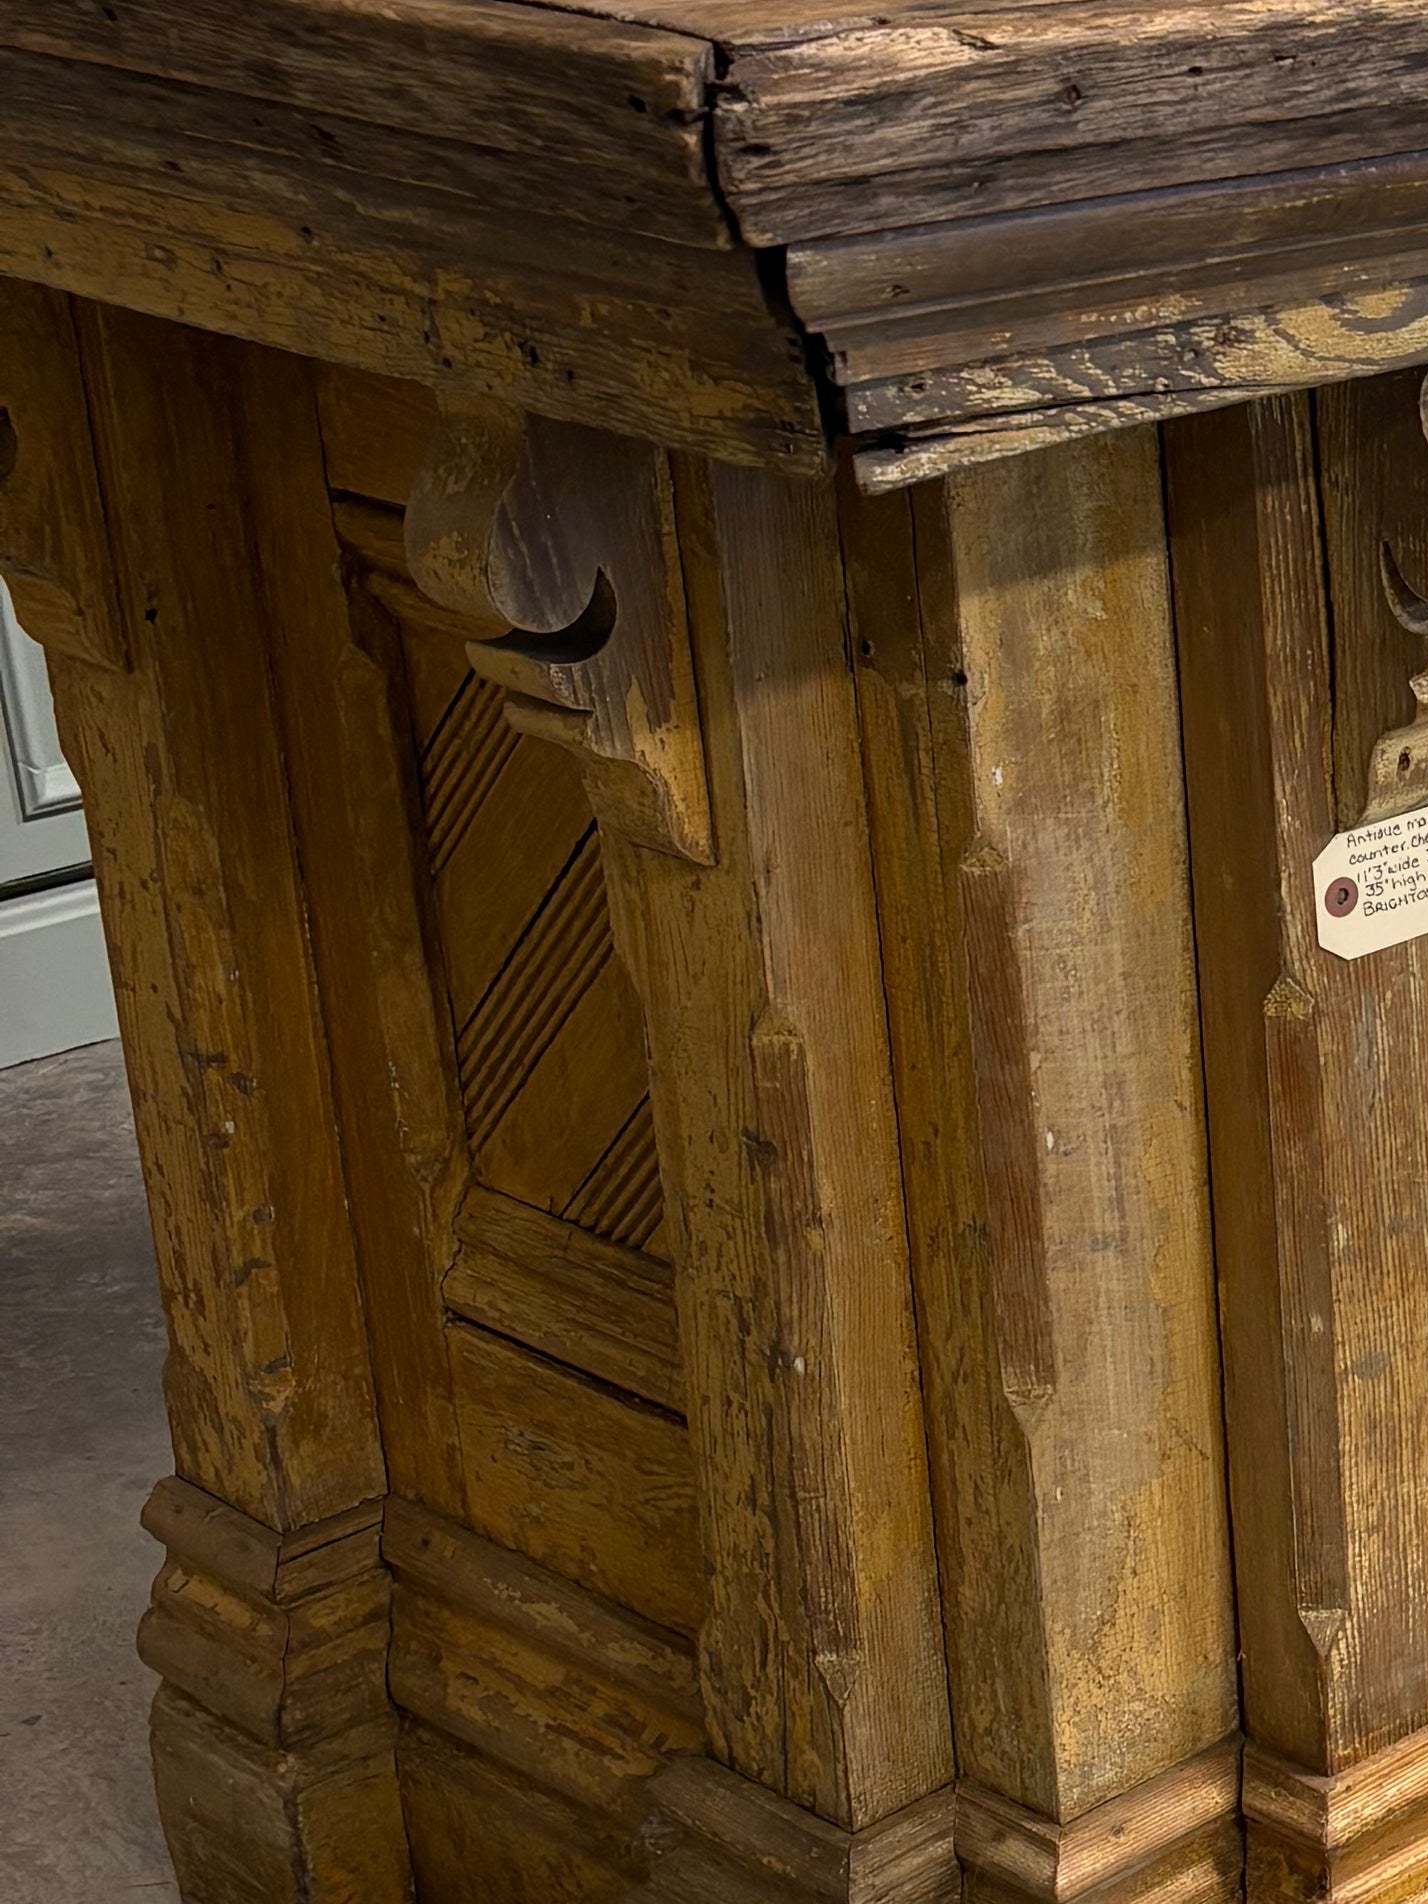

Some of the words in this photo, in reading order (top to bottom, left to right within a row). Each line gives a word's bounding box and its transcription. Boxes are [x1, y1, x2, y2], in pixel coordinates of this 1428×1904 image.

[1346, 824, 1402, 849] Antique
[1387, 856, 1421, 876] wide
[1391, 871, 1427, 893] high
